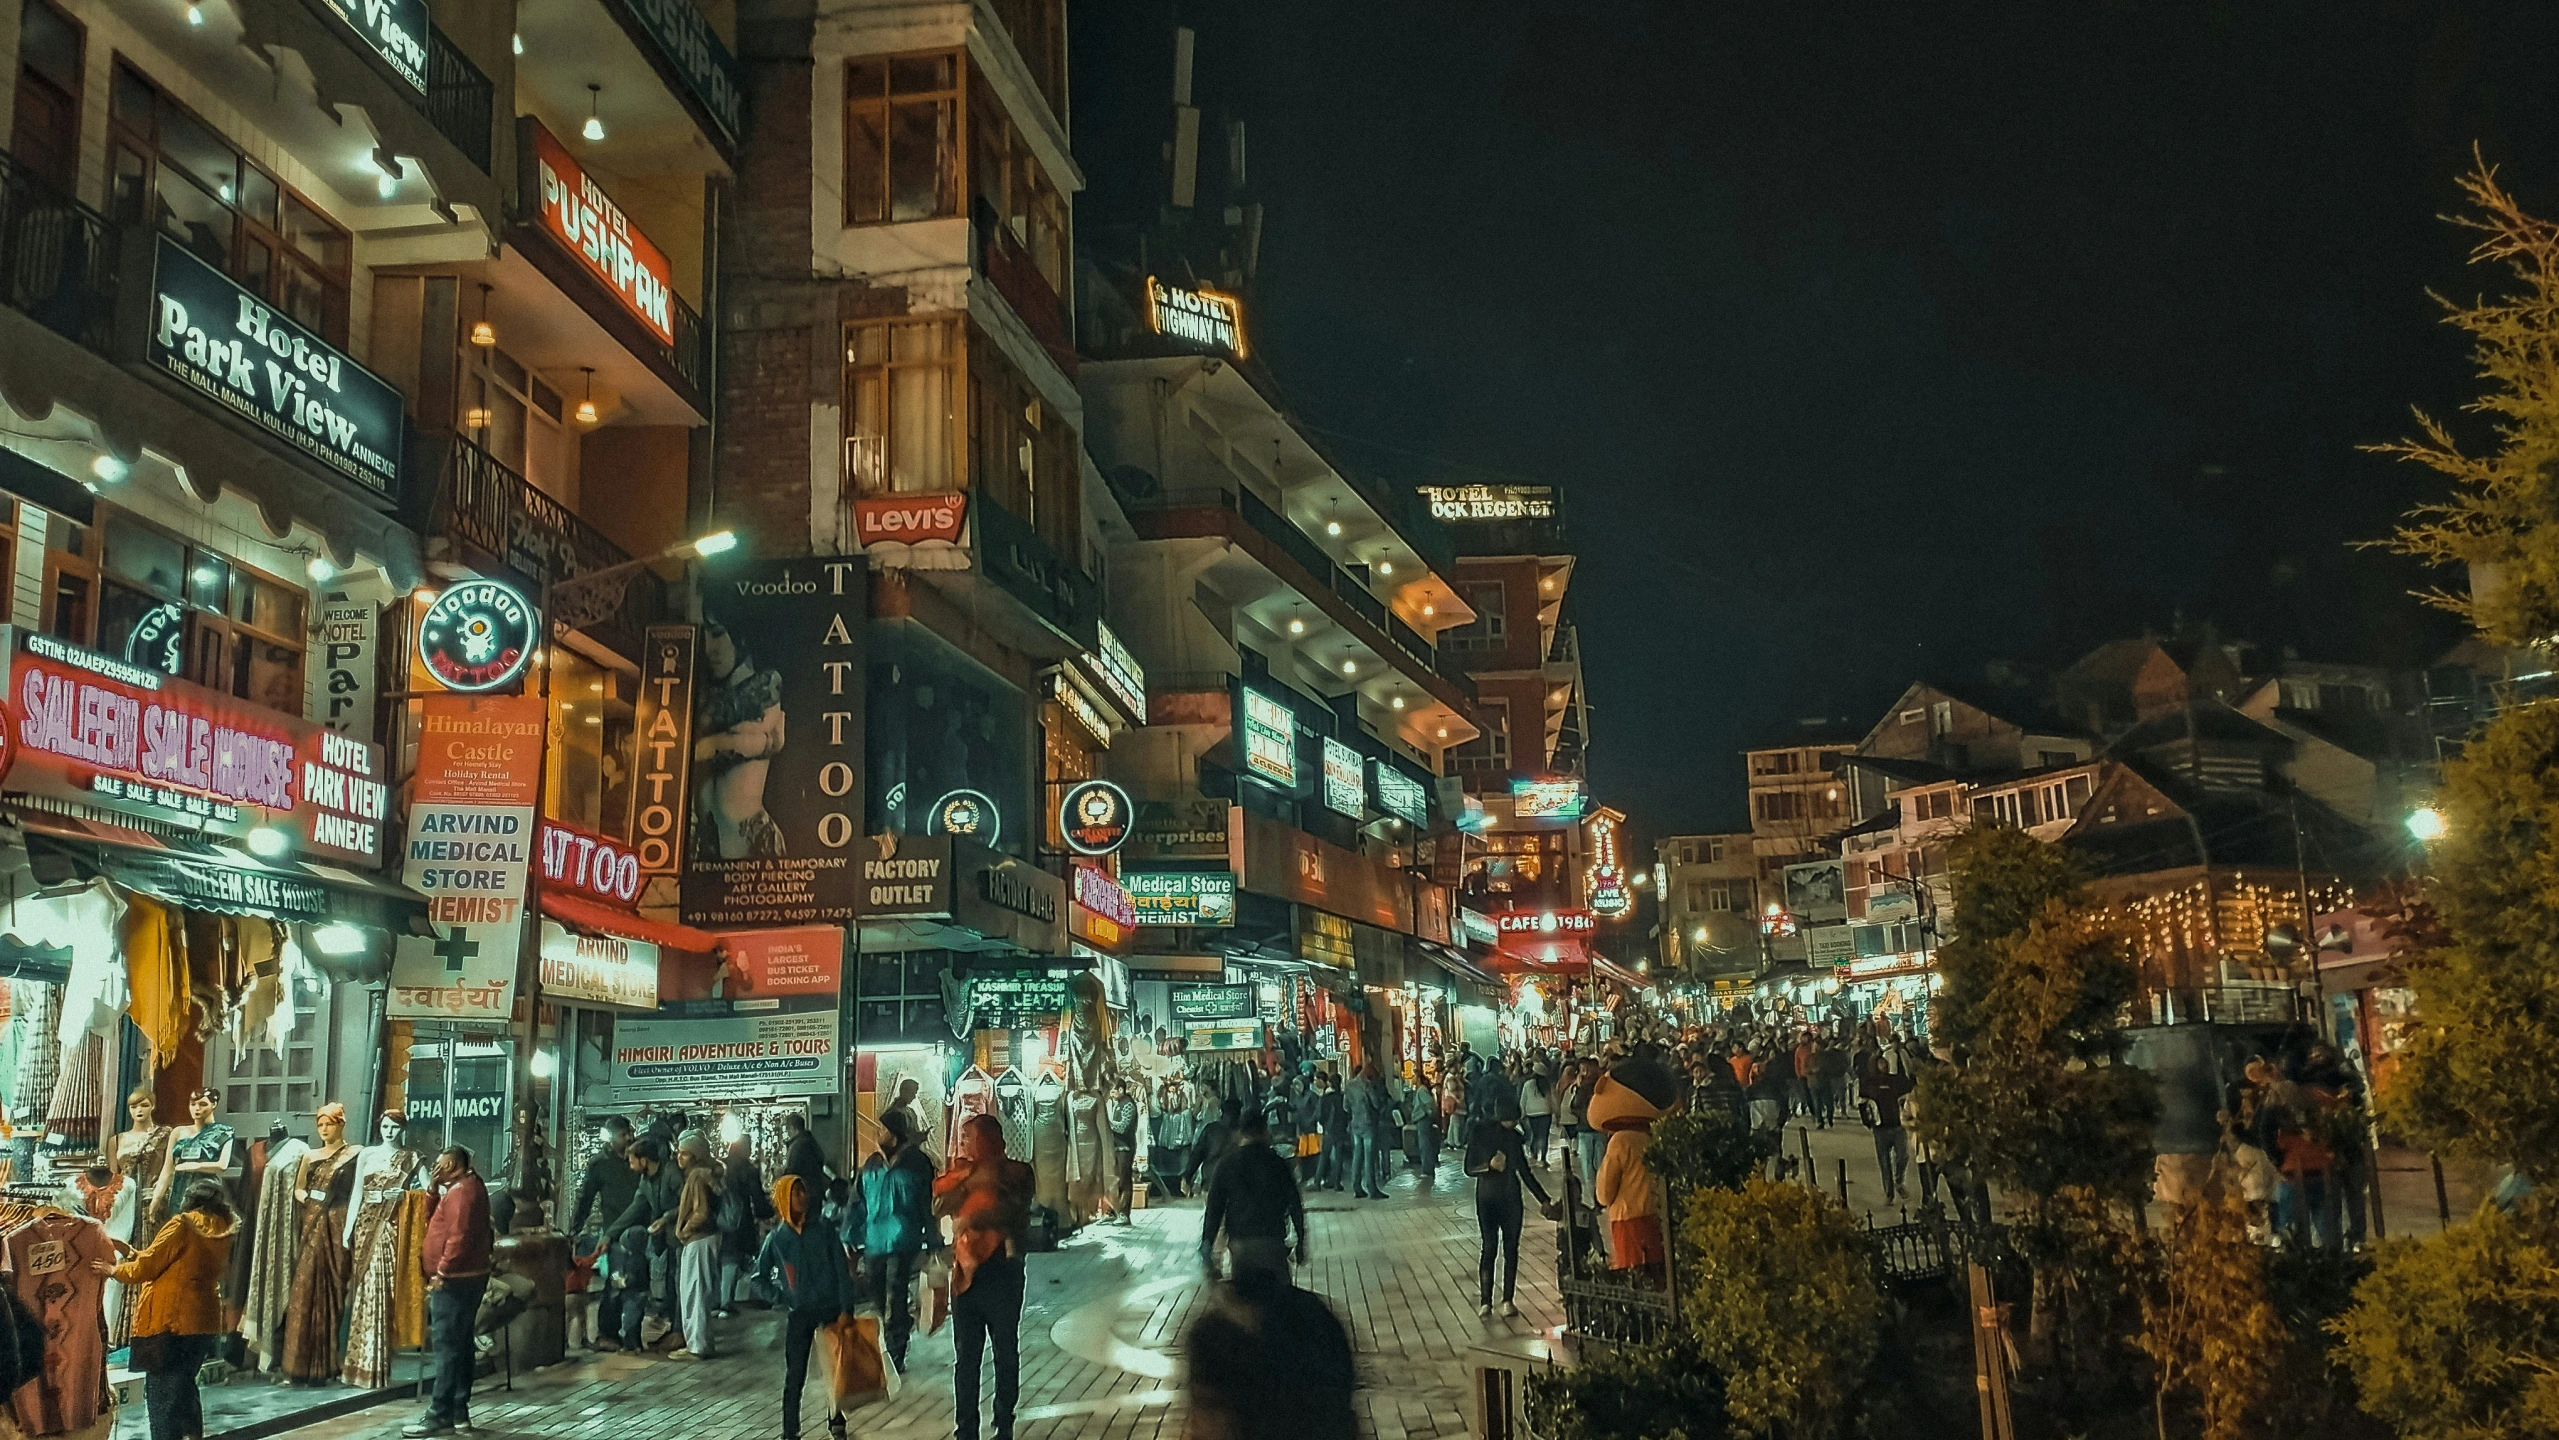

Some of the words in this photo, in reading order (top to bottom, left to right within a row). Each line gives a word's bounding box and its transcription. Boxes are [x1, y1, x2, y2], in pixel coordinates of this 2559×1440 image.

[580, 171, 633, 247] HOTEL
[539, 157, 671, 336] PUSHPAK
[1172, 287, 1230, 321] HOTEL
[1156, 304, 1213, 344] HIGHWAY
[1216, 321, 1238, 351] INN
[236, 294, 341, 393] Hotel
[157, 292, 255, 396] Park
[265, 359, 358, 451] View
[167, 355, 188, 378] THE
[191, 369, 219, 396] MALL
[264, 411, 295, 440] KULLU
[352, 441, 396, 480] ANNEXE
[1428, 487, 1492, 501] HOTEL
[325, 609, 368, 620] WELCOME
[324, 624, 366, 641] HOTEL
[29, 635, 65, 661] GSTIN:
[818, 562, 853, 848] TATTOO
[425, 715, 540, 739] Himalayan
[21, 667, 139, 772] SALEEM
[142, 704, 210, 789] SALE
[212, 727, 294, 810] HOUSE
[322, 733, 371, 775] HOTEL
[447, 741, 514, 761] Castle
[444, 770, 478, 780] Holiday
[481, 771, 509, 780] Rental
[640, 677, 680, 868] TATTOO
[94, 775, 121, 796] SALE
[126, 782, 152, 802] SALE
[157, 790, 183, 809] SALE
[185, 797, 211, 817] SALE
[214, 804, 238, 823] SALE
[304, 761, 347, 813] PARK
[347, 774, 387, 821] VIEW
[313, 813, 375, 855] ANNEXE
[421, 814, 519, 835] ARVIND
[411, 841, 523, 863] MEDICAL
[542, 826, 639, 900] ATTOO
[692, 860, 760, 872] PERMANENT
[765, 861, 774, 870] &
[778, 858, 848, 870] TEMPORARY
[864, 860, 940, 880] FACTORY
[421, 868, 506, 889] STORE
[724, 872, 757, 883] BODY
[761, 870, 815, 882] PIERCING
[732, 883, 752, 893] ART
[757, 882, 807, 893] GALLERY
[1130, 876, 1186, 893] Medical
[1191, 876, 1231, 893] Store
[183, 868, 243, 903] SALEEM
[244, 874, 280, 908] SALE
[282, 882, 326, 914] HOUSE
[724, 894, 814, 906] PHOTOGRAPHY
[870, 885, 933, 905] OUTLET
[429, 897, 519, 923] HEMIST
[1135, 912, 1198, 923] HEMIST
[1500, 916, 1539, 931] CAFE
[576, 938, 628, 965] ARVIND
[767, 955, 809, 964] LARGEST
[768, 944, 802, 953] INDIA'S
[542, 958, 608, 993] MEDICAL
[612, 971, 655, 999] STORE
[767, 967, 786, 975] BUS
[787, 965, 819, 973] TICKET
[767, 976, 809, 985] BOOKING
[811, 975, 830, 983] APP
[1173, 992, 1191, 1001] Him
[1192, 990, 1224, 1001] Medical
[1226, 990, 1248, 1000] Store
[617, 1046, 673, 1064] HIMGIRI
[678, 1041, 764, 1062] ADVENTURE
[769, 1041, 779, 1055] &
[784, 1039, 830, 1056] TOURS
[764, 1061, 779, 1069] Non
[410, 1097, 502, 1119] PHAMACY
[32, 1253, 62, 1270] 450
